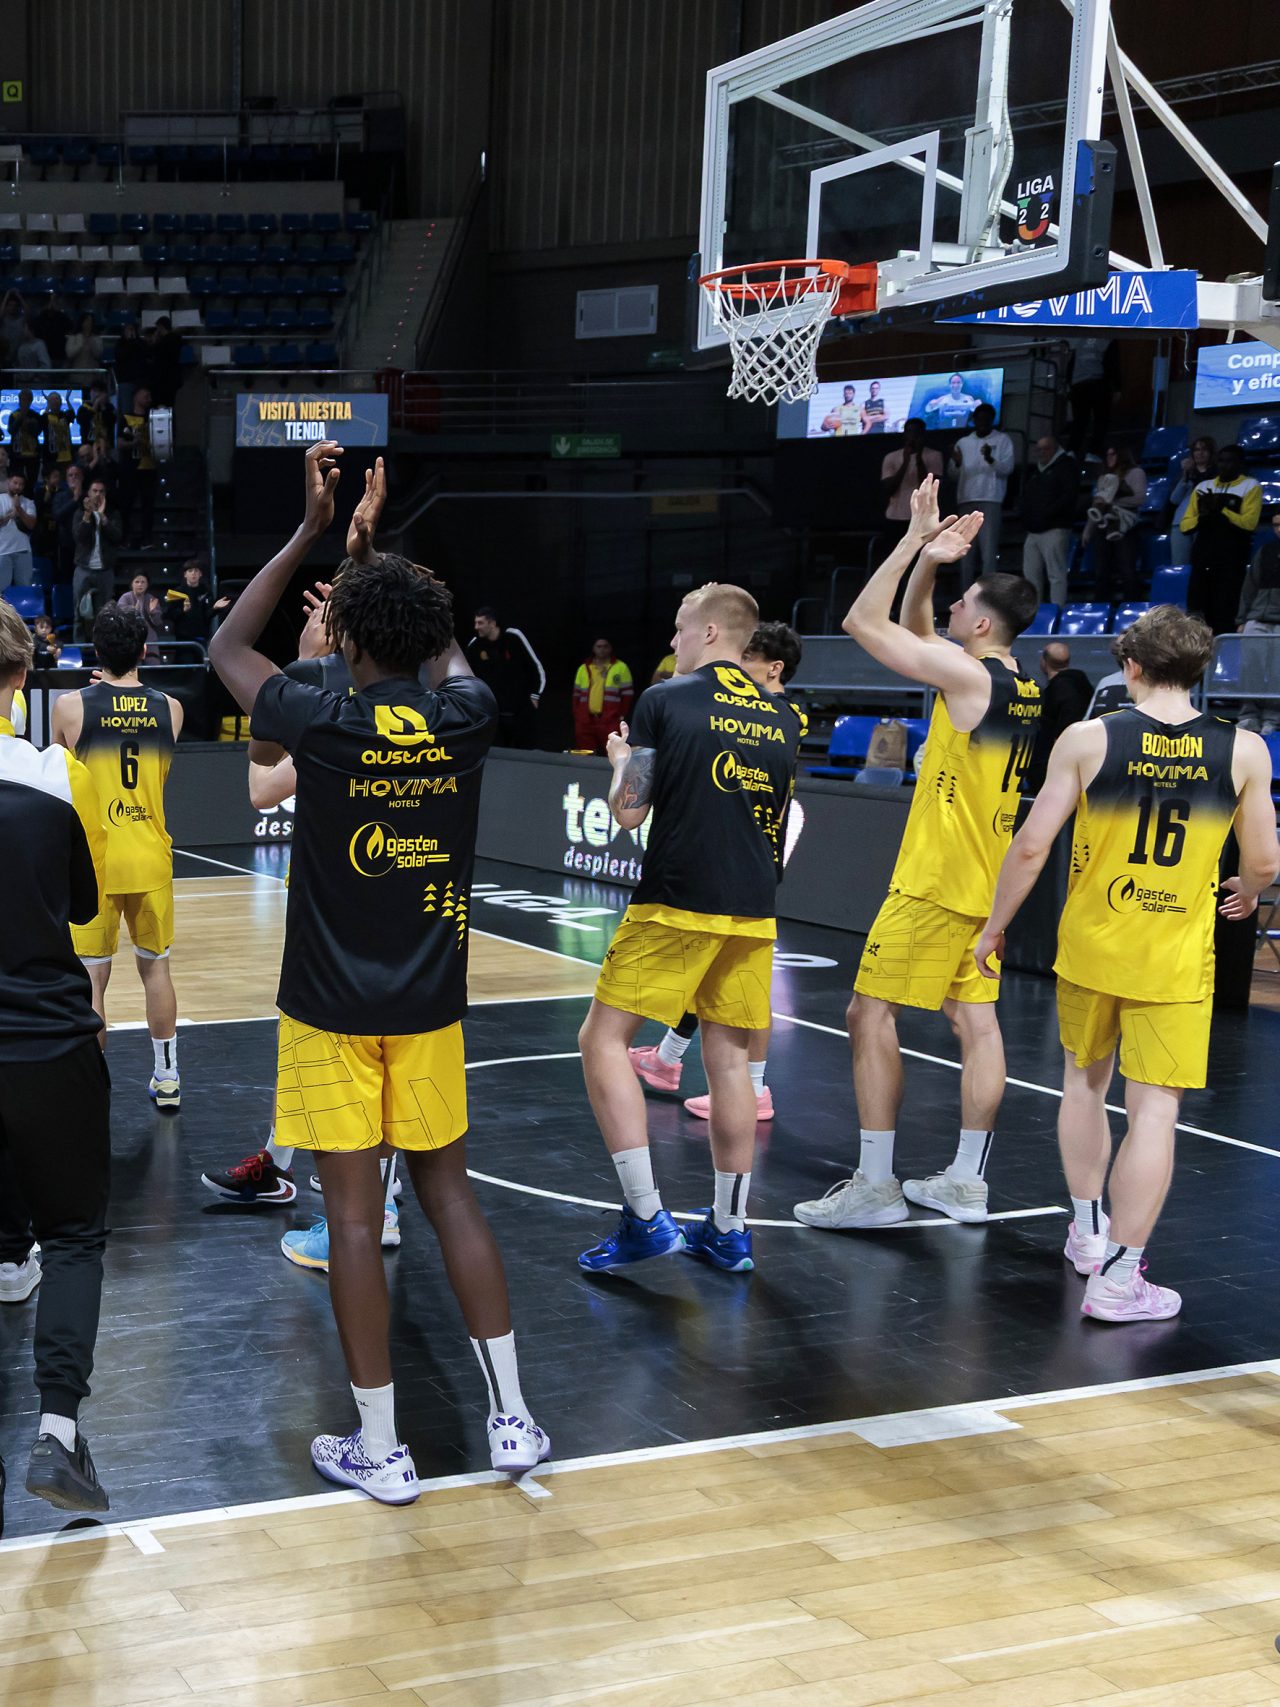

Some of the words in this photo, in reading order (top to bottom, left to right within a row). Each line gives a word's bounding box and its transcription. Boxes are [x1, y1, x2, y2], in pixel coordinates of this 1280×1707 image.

[1017, 174, 1055, 200] LIGA
[1232, 379, 1245, 395] y
[259, 401, 296, 421] VISITA
[299, 401, 352, 420] NUESTRA
[285, 421, 326, 440] TIENDA
[112, 694, 148, 712] LÓPEZ
[713, 691, 779, 714] austral
[100, 716, 158, 728] HOVIMA
[710, 715, 786, 744] HOVIMA
[736, 737, 760, 747] HOTELS
[1142, 731, 1203, 758] BORDÓN
[120, 740, 140, 790] 6
[361, 746, 454, 765] austral
[1127, 760, 1209, 781] HOVIMA
[349, 776, 458, 798] HOVIMA
[388, 799, 421, 809] HOTELS
[1127, 796, 1192, 867] 16
[386, 834, 438, 858] gasten
[397, 854, 429, 869] solar
[1135, 887, 1178, 903] gasten
[1141, 901, 1168, 914] solar
